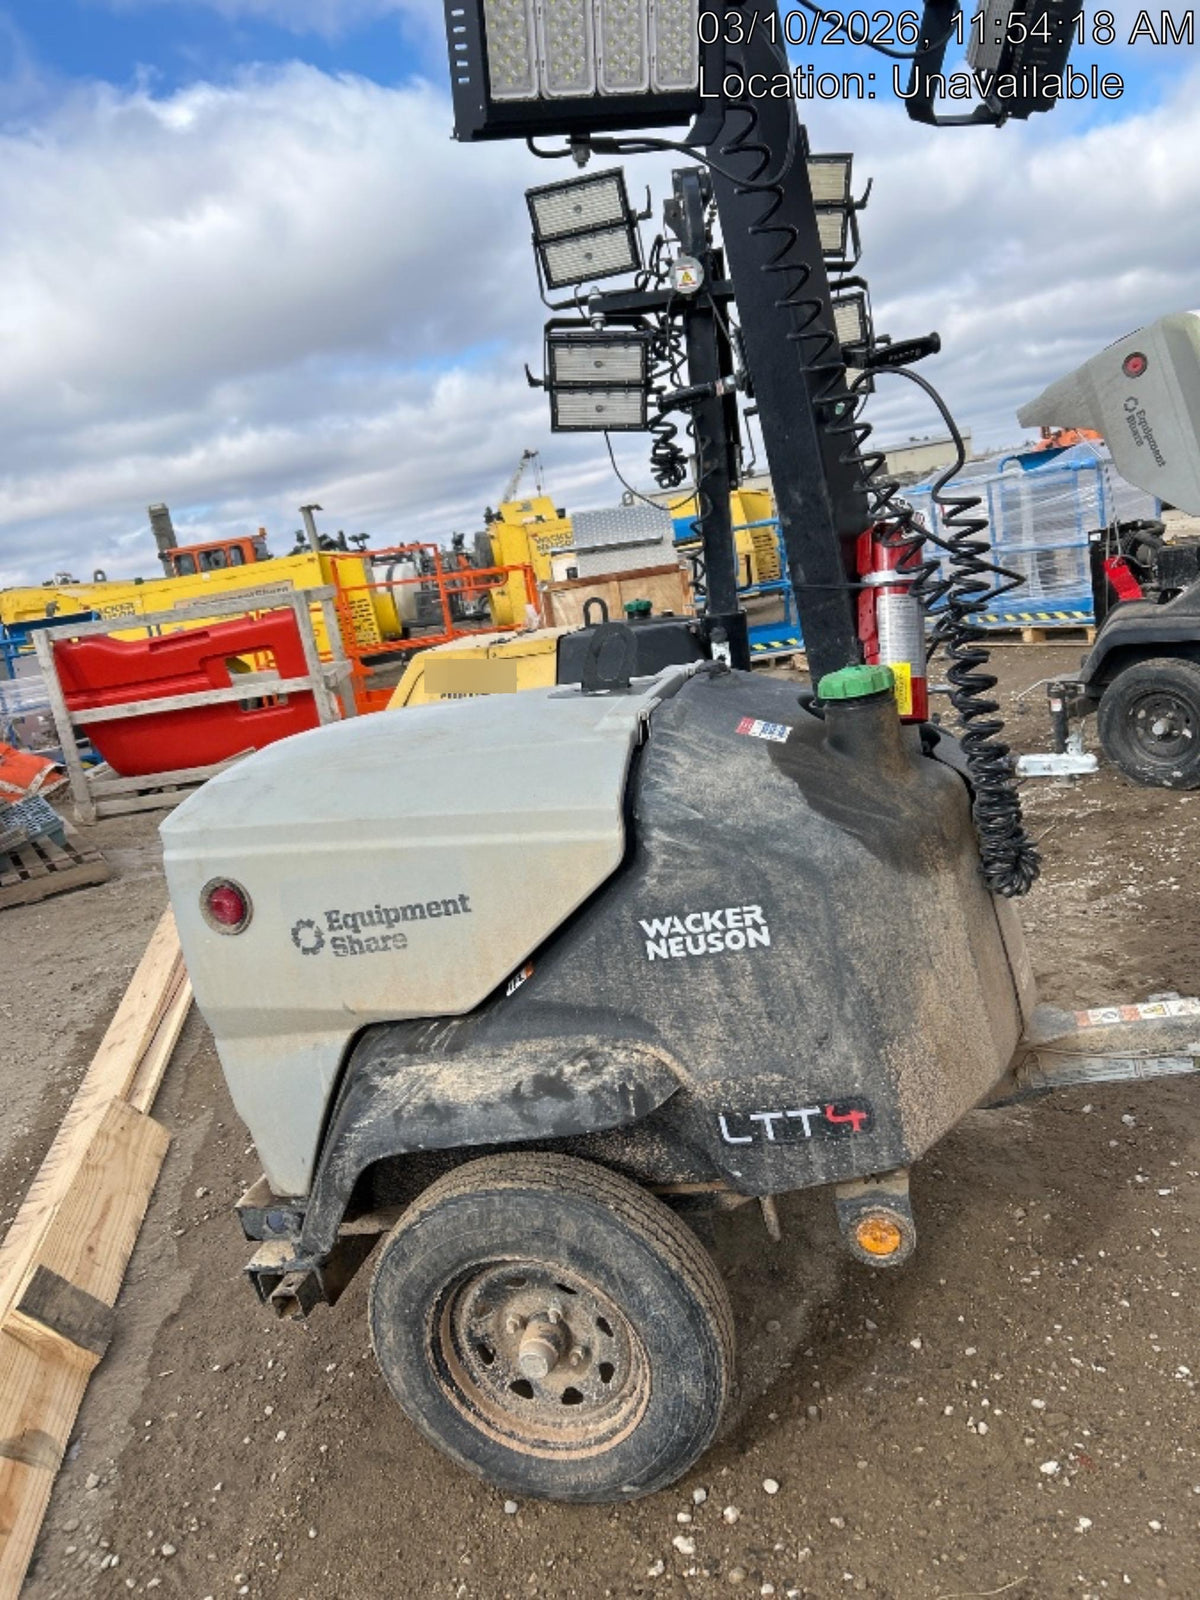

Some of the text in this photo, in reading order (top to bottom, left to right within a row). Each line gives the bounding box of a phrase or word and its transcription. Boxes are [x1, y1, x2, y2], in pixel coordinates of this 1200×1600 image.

[324, 894, 472, 934] Equipment
[638, 904, 767, 939] WACKER
[330, 932, 408, 958] Share
[645, 926, 771, 961] NEUSON
[718, 1104, 867, 1144] LTT4
